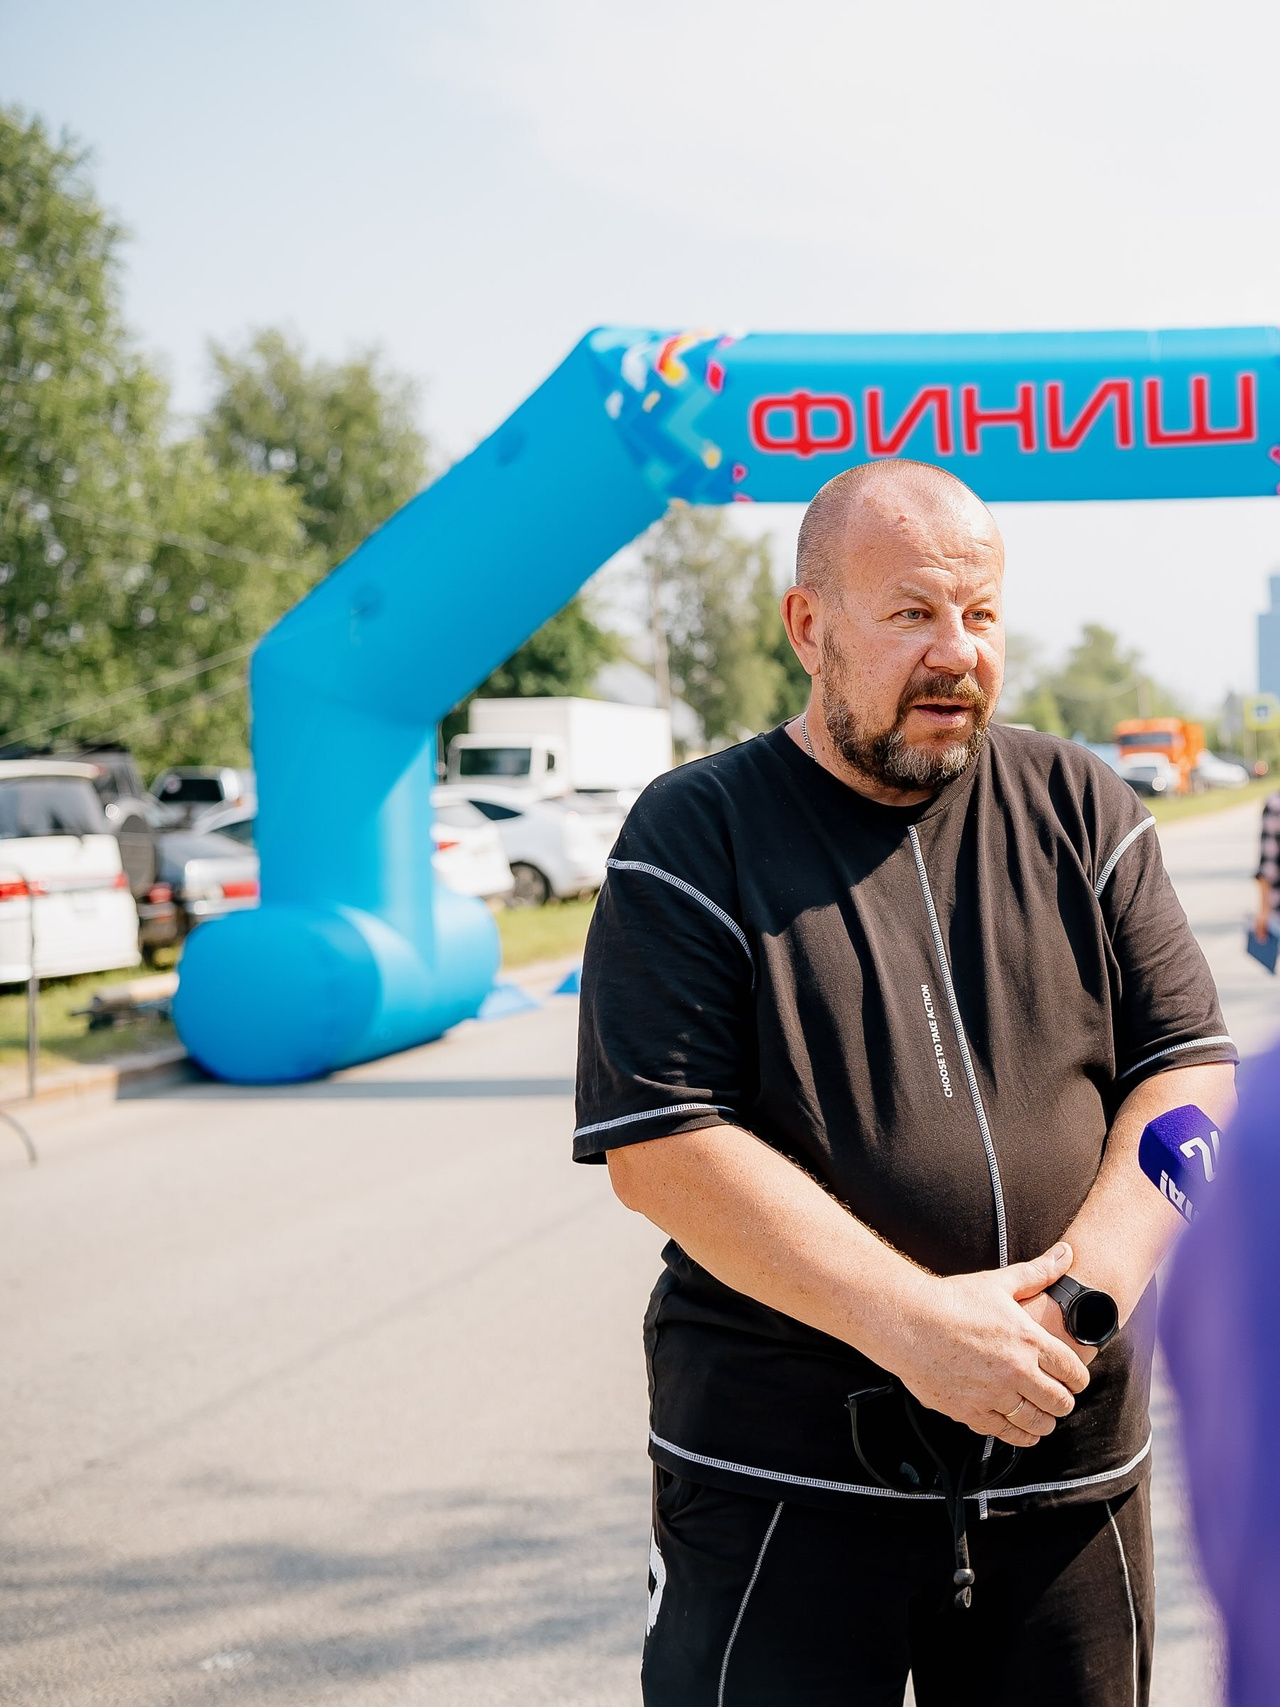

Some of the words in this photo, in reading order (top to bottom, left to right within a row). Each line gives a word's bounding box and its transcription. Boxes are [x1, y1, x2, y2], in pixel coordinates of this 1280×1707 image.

[750, 373, 1257, 459] ФИНИШ
[920, 984, 936, 1020] ACTION
[928, 1020, 941, 1044] TAKE
[934, 1043, 945, 1058] TO
[937, 1058, 953, 1098] CHOOSE
